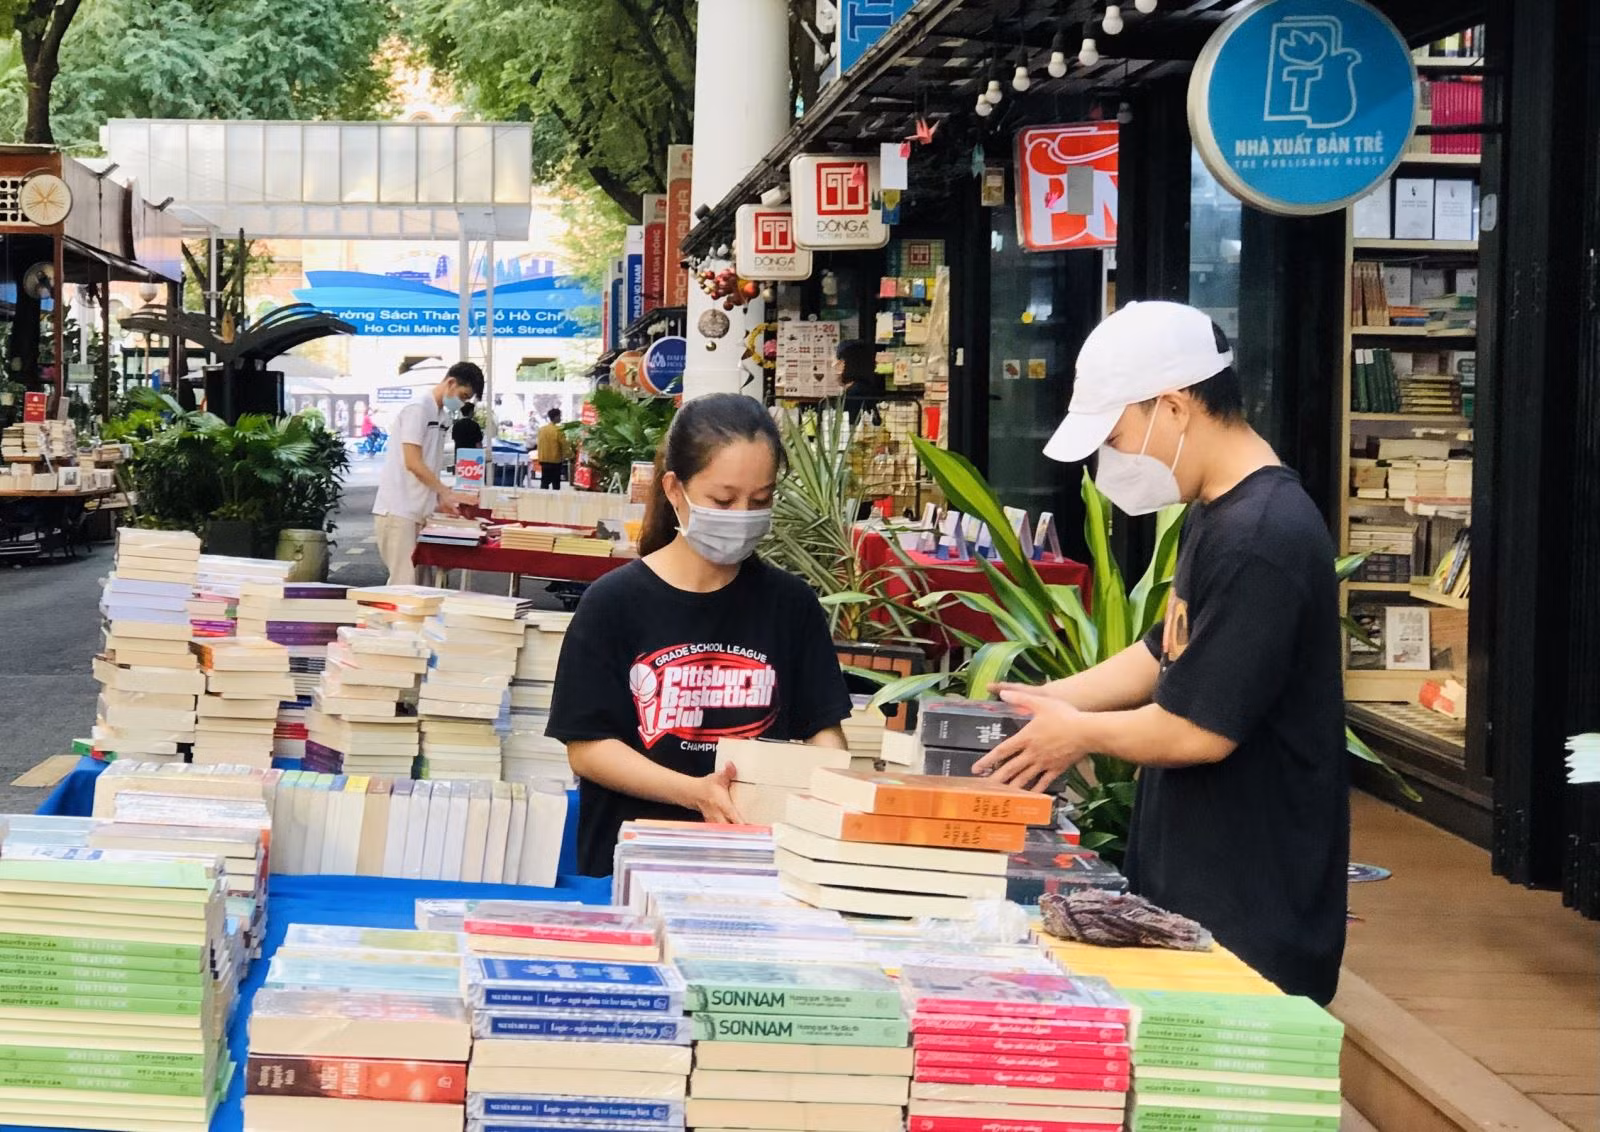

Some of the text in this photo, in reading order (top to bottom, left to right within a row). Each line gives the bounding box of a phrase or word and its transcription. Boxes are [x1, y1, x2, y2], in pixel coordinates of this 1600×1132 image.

[1235, 130, 1384, 156] NHÀ XUẤT BẢN TRẺ
[380, 310, 418, 320] Sách
[422, 310, 462, 320] Thàn
[475, 309, 505, 320] Pố
[509, 310, 531, 320] Hồ
[364, 324, 384, 333] Ho
[387, 324, 410, 333] Chi
[414, 325, 446, 333] Minh
[450, 325, 476, 335] Cy
[518, 326, 557, 334] Street
[655, 643, 768, 667] GRADE SCHOOL LEAGUE
[664, 664, 776, 688] Pittsburgh
[660, 686, 774, 708] Basketball
[657, 706, 704, 730] Club
